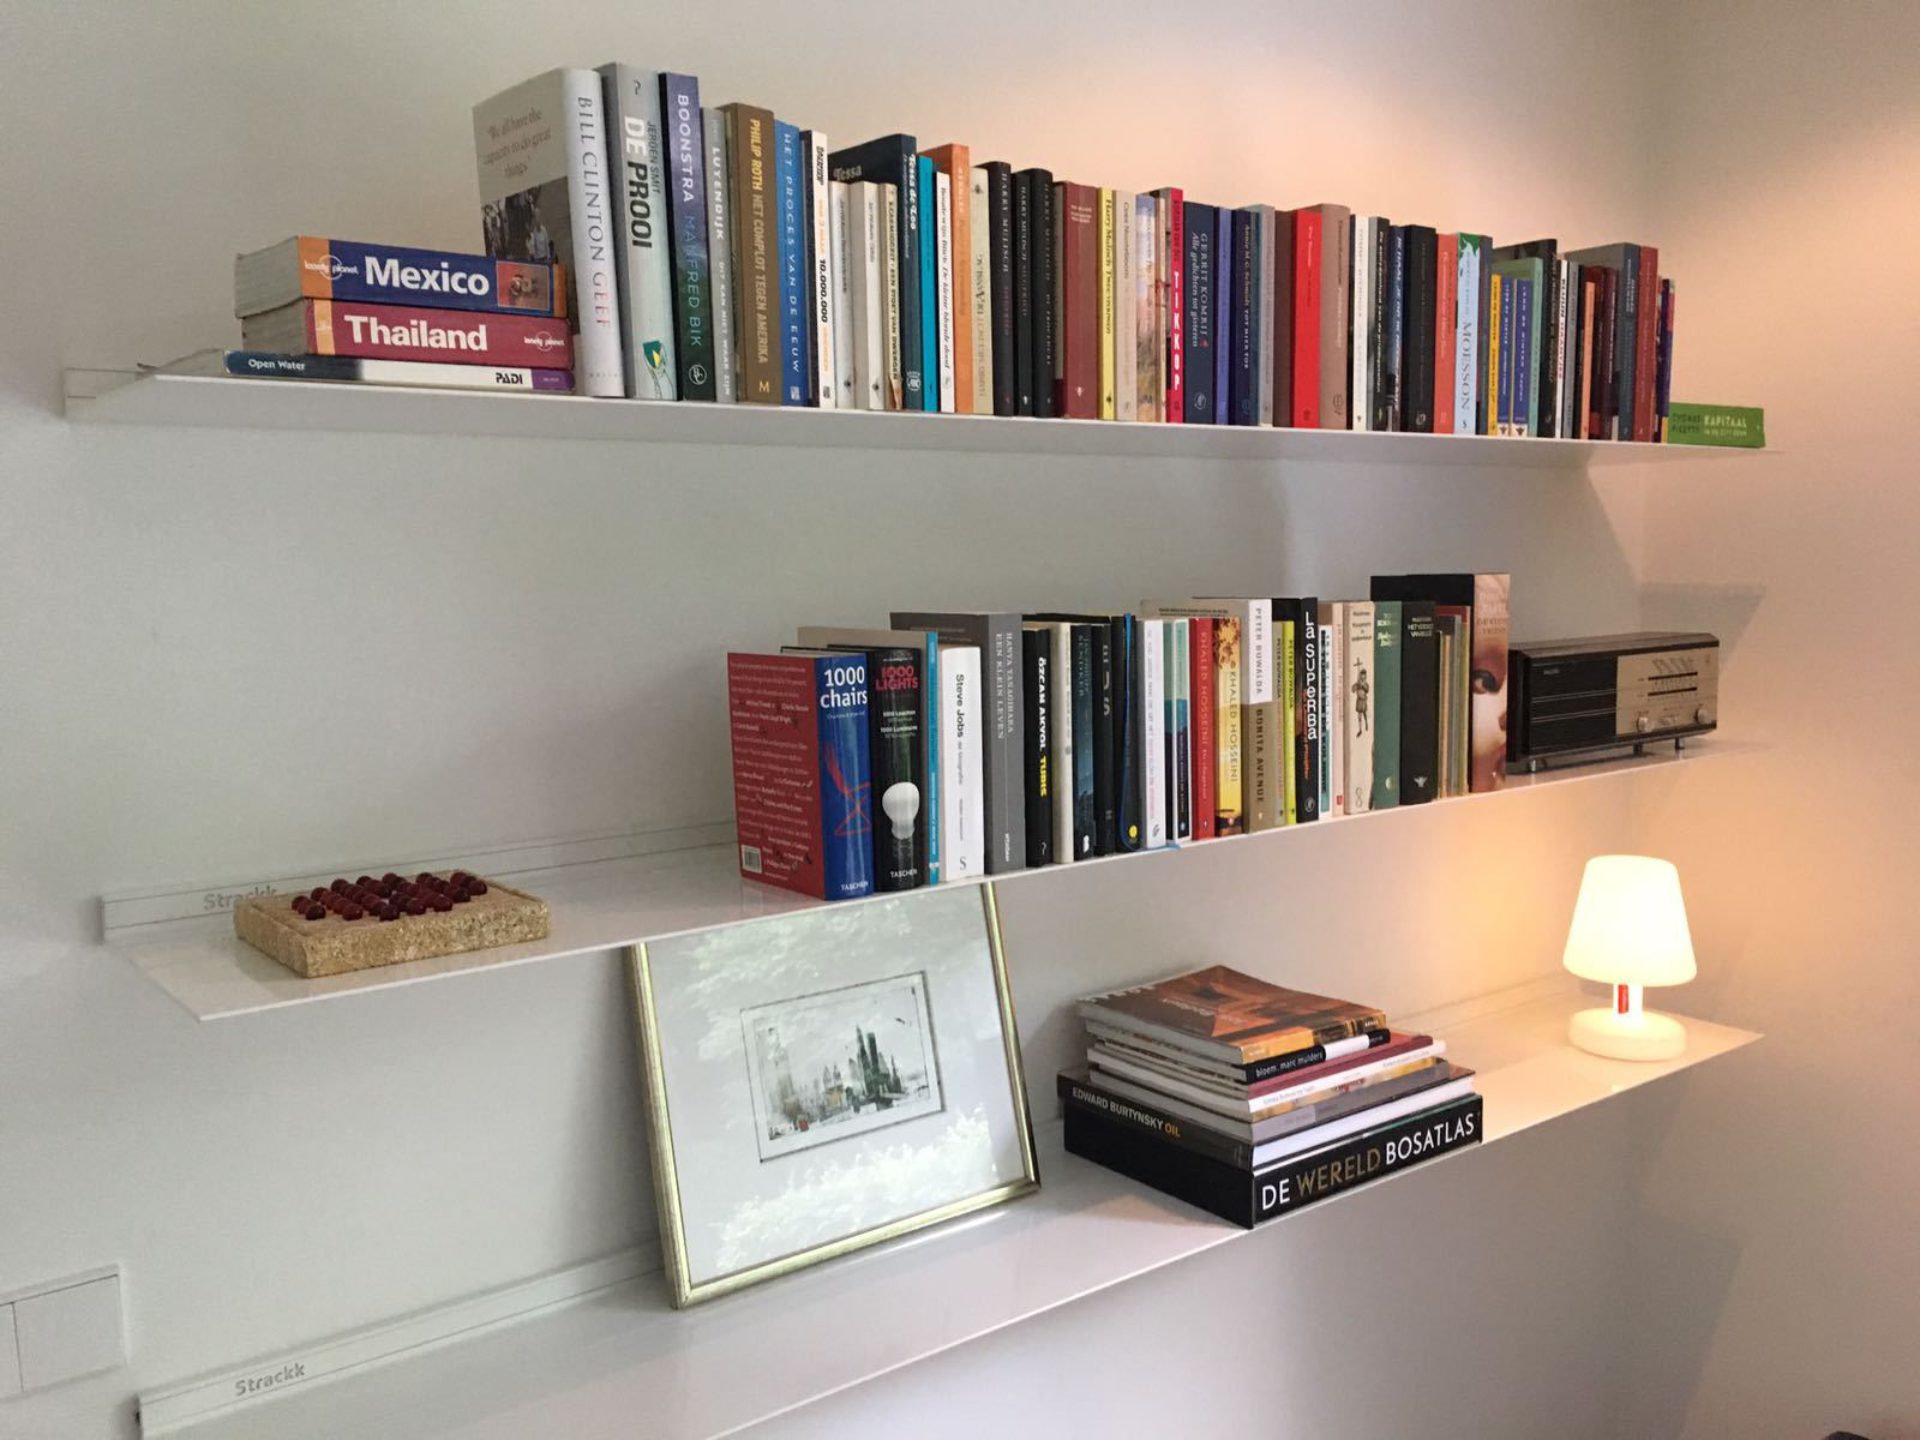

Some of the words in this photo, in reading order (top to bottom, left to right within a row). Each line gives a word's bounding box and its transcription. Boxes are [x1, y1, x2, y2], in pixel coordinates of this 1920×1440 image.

[577, 96, 594, 144] BILL
[624, 115, 647, 155] DE
[749, 119, 761, 158] PHILIP
[647, 121, 659, 162] JEROEN
[678, 94, 695, 203] BOONSTRA
[784, 133, 793, 168] HET
[649, 164, 661, 195] SMIT
[751, 160, 763, 191] ROTH
[909, 153, 917, 187] Tessa
[582, 151, 604, 262] CLINTON
[628, 160, 653, 249] PROOI
[713, 146, 724, 241] LUYENDIJK
[753, 194, 764, 217] HET
[786, 176, 795, 246] PROCES
[909, 188, 916, 203] de
[684, 214, 700, 309] MANFRED
[754, 218, 766, 273] COMPLOT
[1200, 233, 1208, 282] GERRIT
[304, 260, 330, 273] lonely
[332, 262, 358, 275] planet
[364, 256, 490, 296] Mexico
[788, 254, 797, 288] VAN
[1190, 251, 1199, 296] gedichten
[592, 272, 611, 328] GEEF
[755, 273, 767, 311] TEGEN
[790, 295, 798, 316] DE
[819, 258, 828, 323] 10.000.000
[1190, 311, 1199, 348] gisteren
[1200, 285, 1208, 336] KOMRIJ
[343, 315, 489, 351] Thailand
[524, 336, 543, 346] lonely
[545, 337, 565, 347] planet
[689, 315, 702, 347] BIK
[756, 312, 769, 364] AMERIKA
[791, 324, 800, 373] EEUW
[248, 358, 274, 371] Open
[275, 359, 305, 371] Water
[495, 372, 523, 385] PADI
[1461, 322, 1472, 411] MOESSON
[1703, 415, 1747, 428] KAPITAAL
[1306, 611, 1316, 639] La
[881, 665, 914, 678] 1000
[1200, 631, 1208, 681] KHALED
[824, 665, 865, 687] 1000
[875, 677, 918, 690] LIGHTS
[956, 673, 965, 707] Steve
[1038, 656, 1047, 704] ÖZCAN
[820, 687, 868, 708] chairs
[956, 709, 965, 738] Jobs
[1256, 708, 1264, 753] BONITA
[1230, 724, 1238, 782] HOSSEINI
[1256, 757, 1264, 803] AVENUE
[841, 880, 869, 892] TASCHEN
[889, 867, 918, 879] TASCHEN
[1280, 1060, 1296, 1071] marc
[1298, 1052, 1323, 1068] mulders
[1073, 1086, 1108, 1111] EDWARD
[1109, 1097, 1164, 1131] BURTYNSKY
[1164, 1121, 1181, 1139] OIL
[1261, 1178, 1291, 1211] DE
[1296, 1147, 1381, 1197] WERELD
[1385, 1112, 1475, 1166] BOSATLAS
[234, 1362, 305, 1396] Strackk
